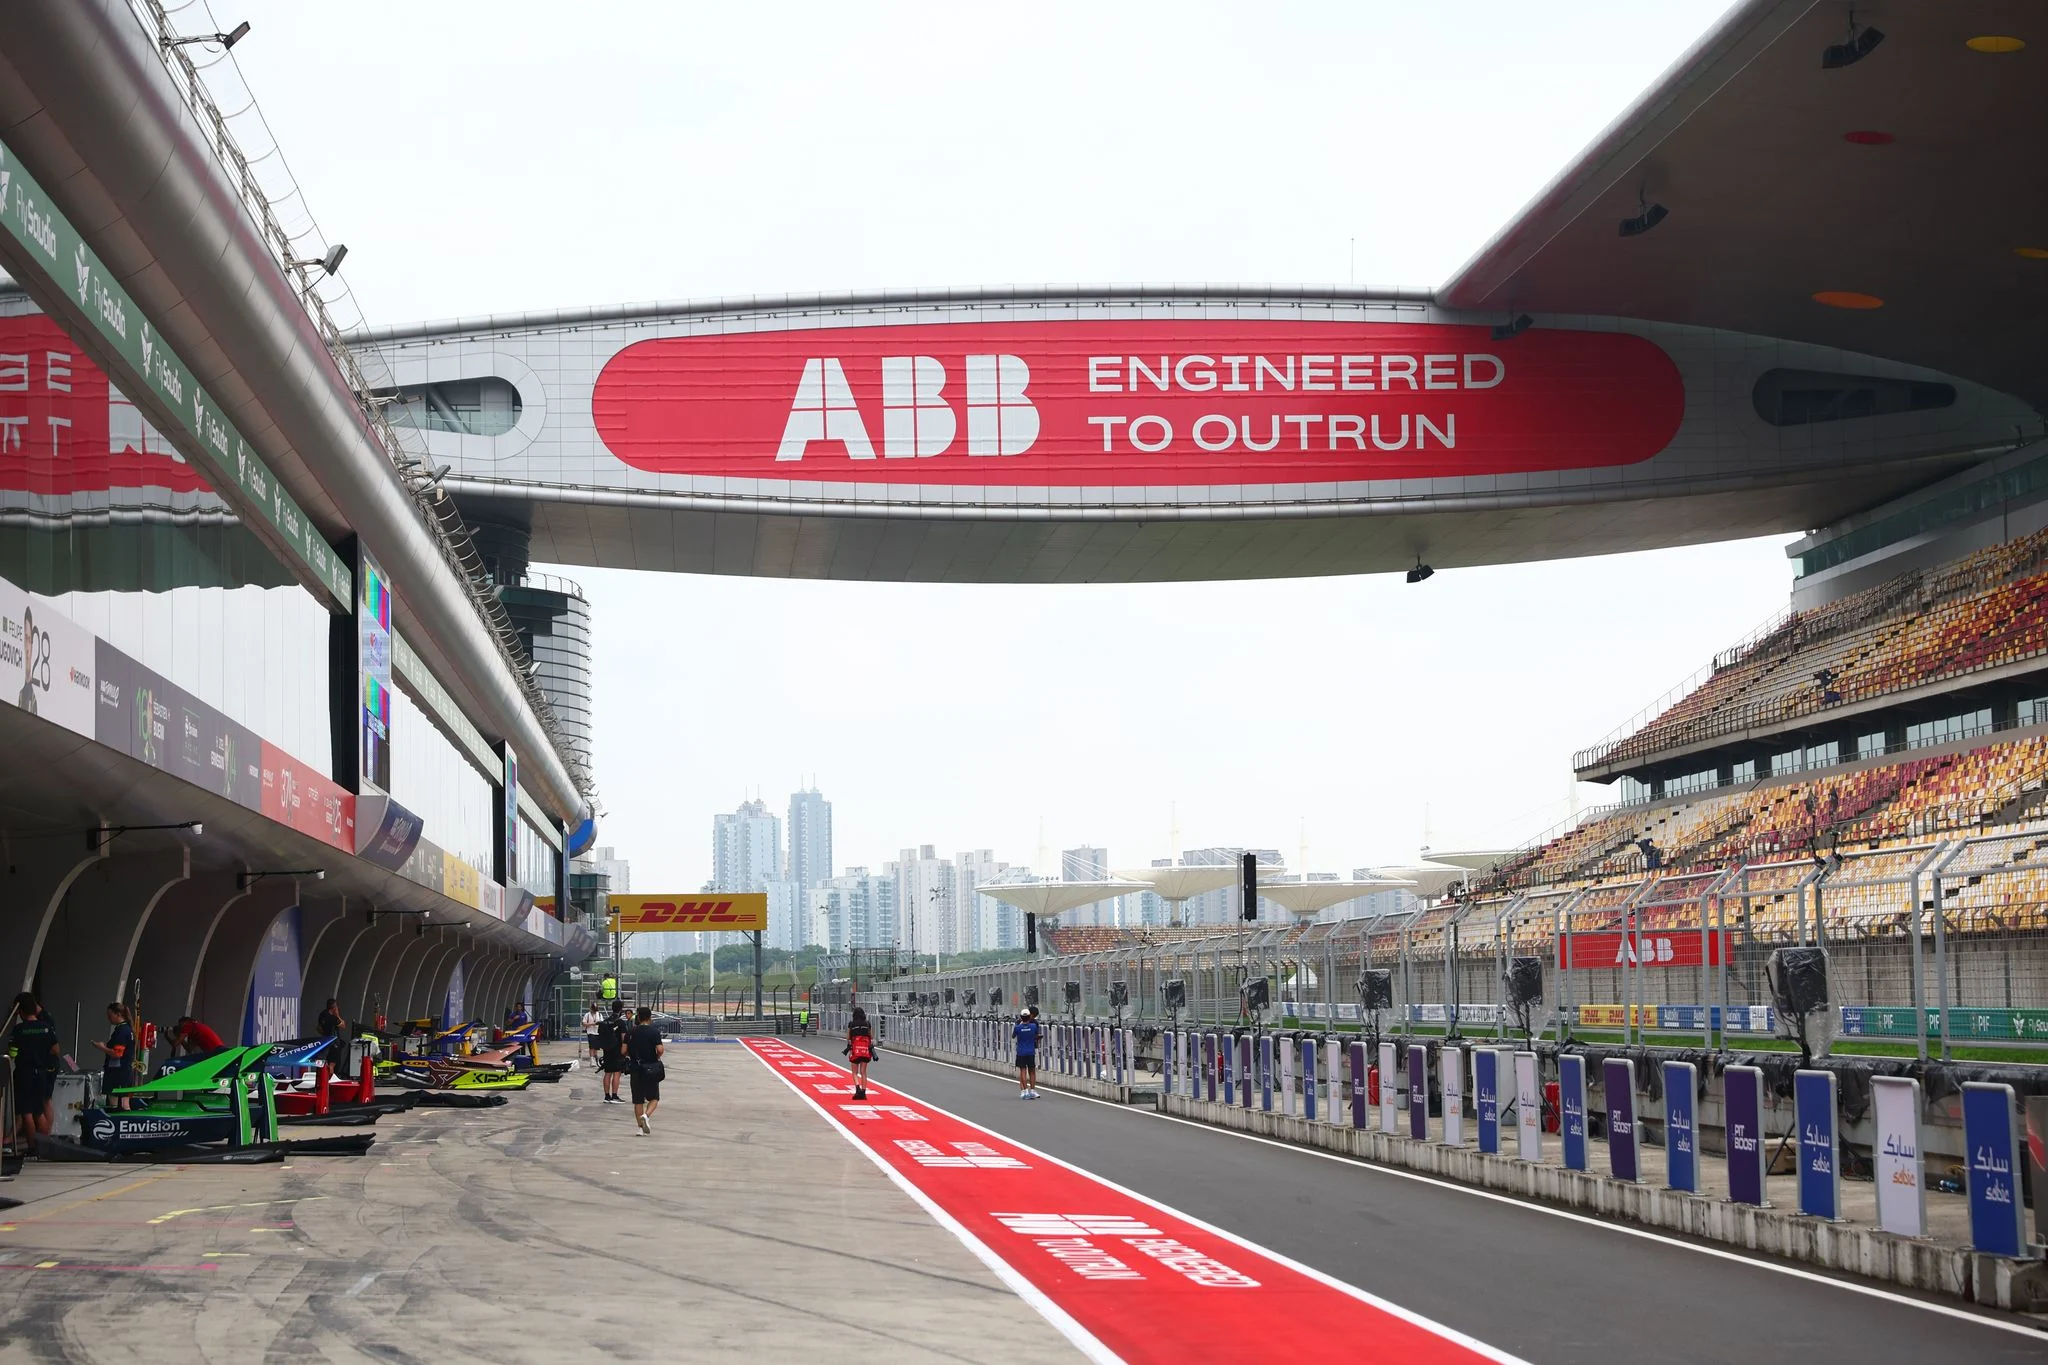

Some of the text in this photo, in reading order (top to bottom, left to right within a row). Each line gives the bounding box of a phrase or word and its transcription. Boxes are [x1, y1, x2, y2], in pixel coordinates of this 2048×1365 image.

[1088, 354, 1506, 392] ENGINEERED
[775, 354, 1040, 462] ABB
[1088, 414, 1456, 452] TO OUTRUN
[32, 626, 50, 692] 28
[638, 902, 738, 923] DHL
[1616, 938, 1674, 962] ABB
[256, 996, 298, 1045] SHANGHAI
[1883, 1014, 1894, 1028] PIF
[1929, 1014, 1940, 1029] PIF
[1978, 1016, 1990, 1032] PIF
[270, 1046, 284, 1054] 37
[120, 1120, 180, 1132] Envision
[1613, 1110, 1621, 1121] PIT
[1613, 1121, 1631, 1134] BOOST
[1734, 1124, 1745, 1137] PIT
[1734, 1137, 1756, 1152] BOOST
[1812, 1152, 1831, 1173] sabic
[1892, 1164, 1916, 1186] sabic
[1985, 1178, 2010, 1204] sabic
[1121, 1238, 1262, 1288] ENGINEERED
